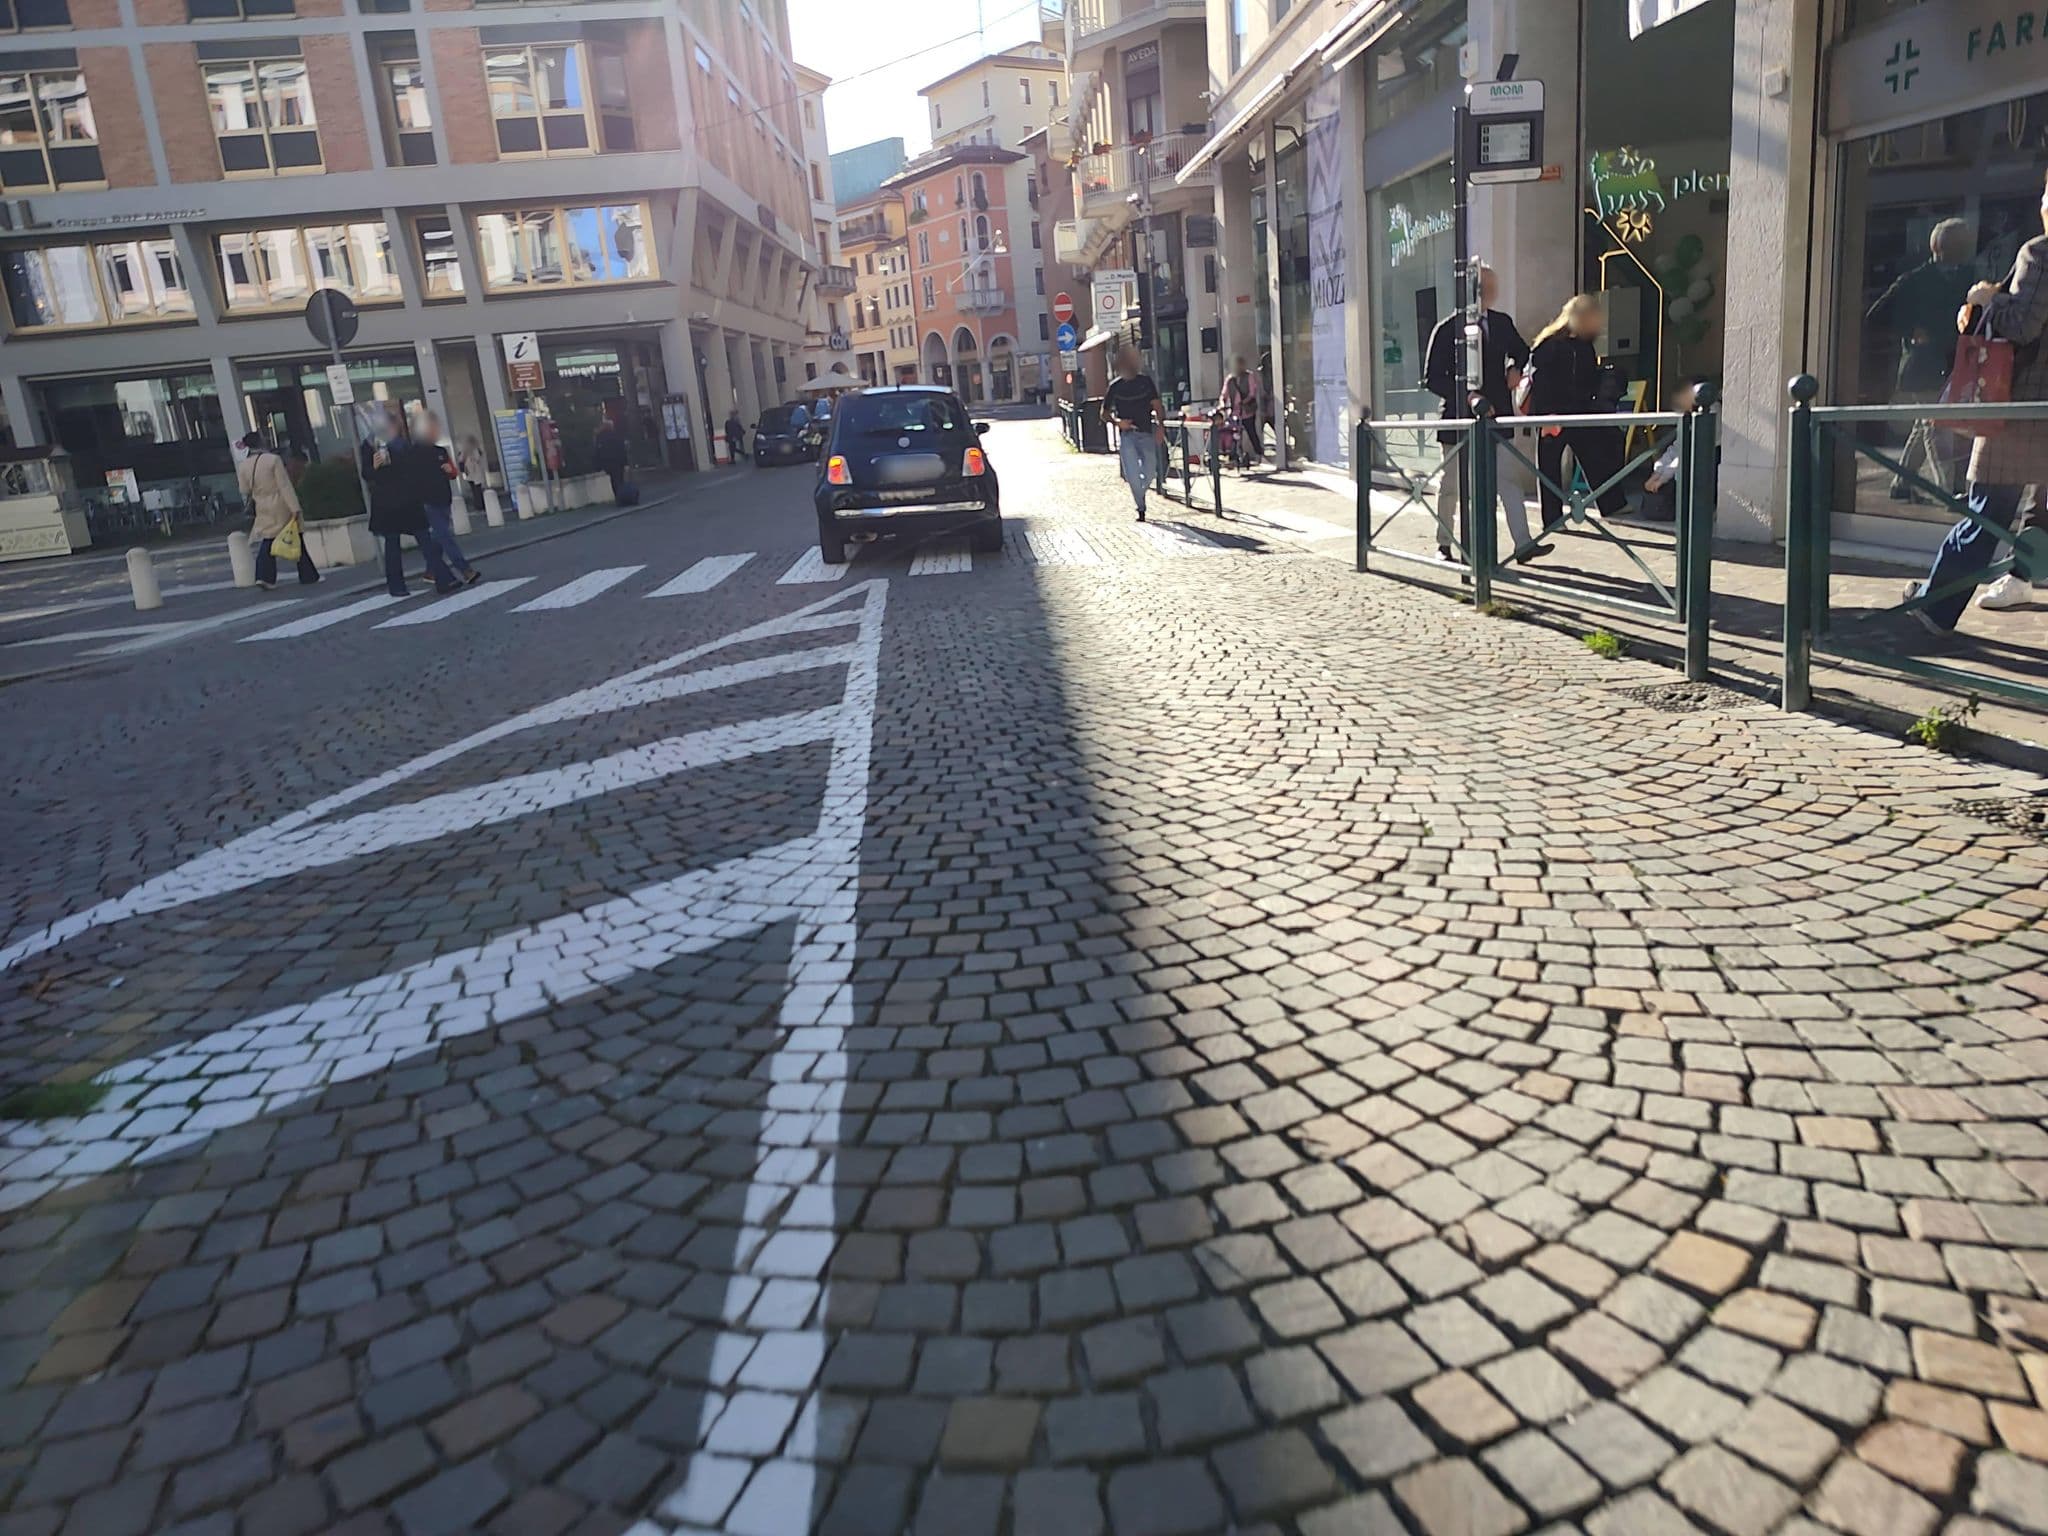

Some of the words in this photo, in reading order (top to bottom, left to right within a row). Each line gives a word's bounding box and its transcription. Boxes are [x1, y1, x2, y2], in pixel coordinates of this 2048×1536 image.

[1968, 8, 2048, 61] FAR
[1127, 46, 1156, 64] AVEDA
[1490, 84, 1524, 96] MOM
